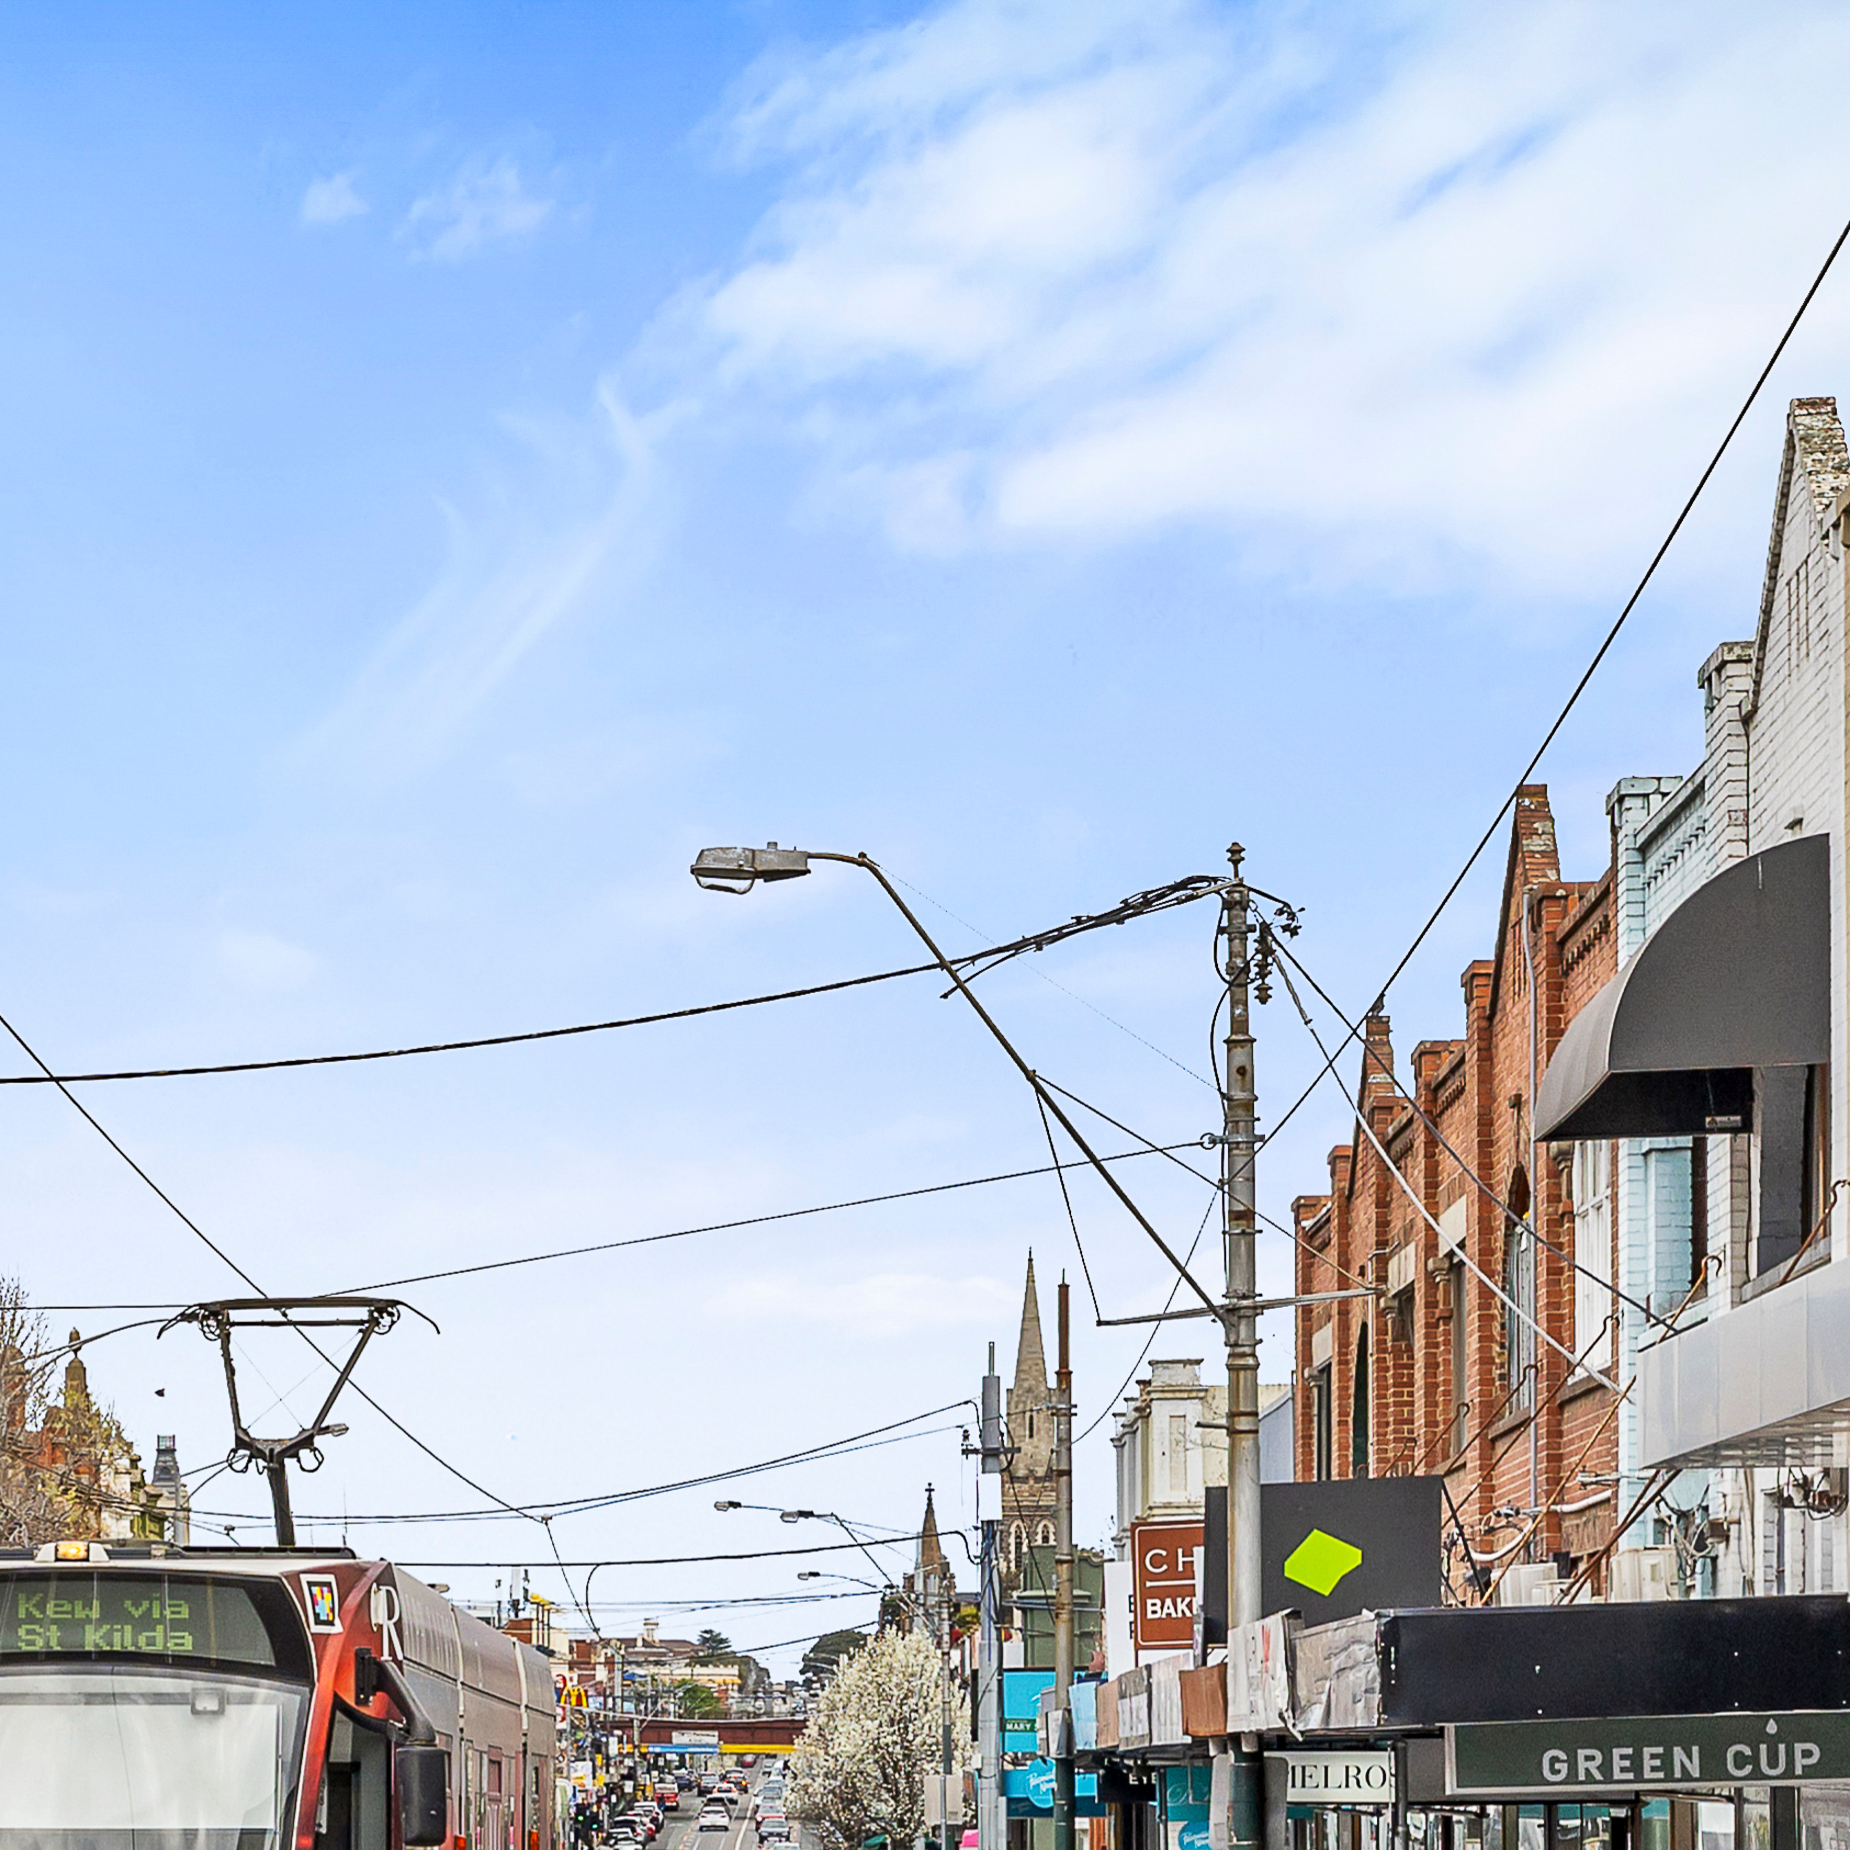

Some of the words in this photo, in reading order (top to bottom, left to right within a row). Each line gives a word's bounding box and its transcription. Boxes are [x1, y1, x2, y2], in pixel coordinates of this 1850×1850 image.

[17, 1593, 100, 1619] Kew
[124, 1593, 190, 1619] via
[17, 1624, 61, 1651] St
[84, 1624, 193, 1651] Kilda
[1005, 1722, 1031, 1731] MARY
[1542, 1745, 1701, 1783] GREEN
[1726, 1741, 1822, 1778] CUP
